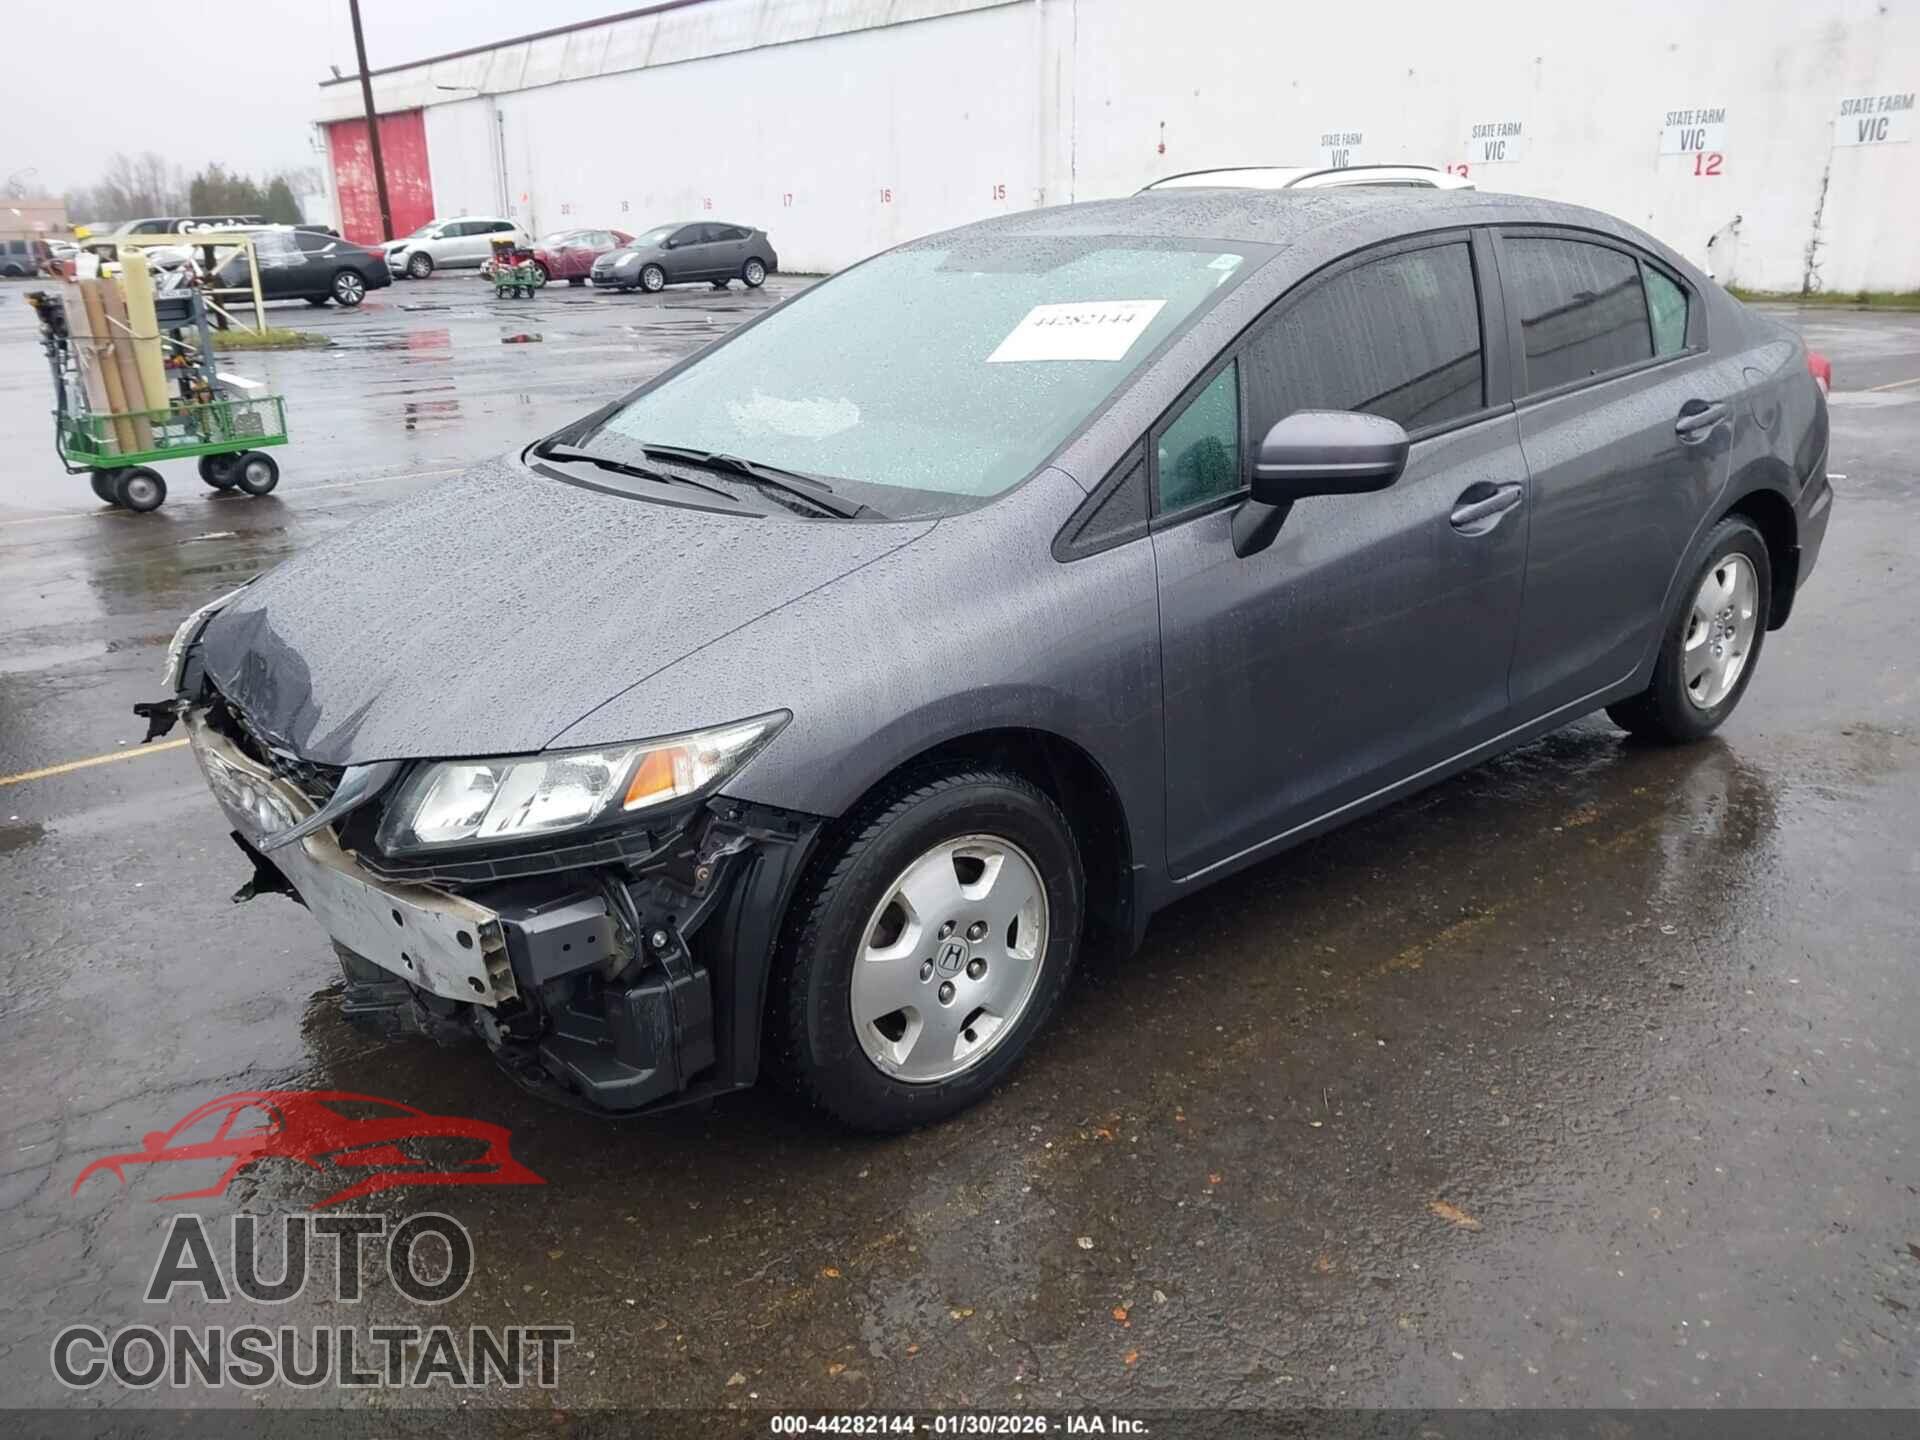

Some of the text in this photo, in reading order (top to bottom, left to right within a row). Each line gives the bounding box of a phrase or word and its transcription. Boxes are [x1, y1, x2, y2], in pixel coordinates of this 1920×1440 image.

[1840, 93, 1916, 117] STATE FARM
[1665, 108, 1726, 127] STATE FARM
[1471, 122, 1522, 139] STATE FARM
[1857, 116, 1889, 143] VIC
[1321, 133, 1362, 147] STATE FARM
[1680, 128, 1706, 151] VIC
[1331, 149, 1350, 167] VIC
[1484, 140, 1506, 161] VIC
[1693, 153, 1723, 177] 12
[783, 193, 793, 207] 17
[993, 184, 1006, 201] 15
